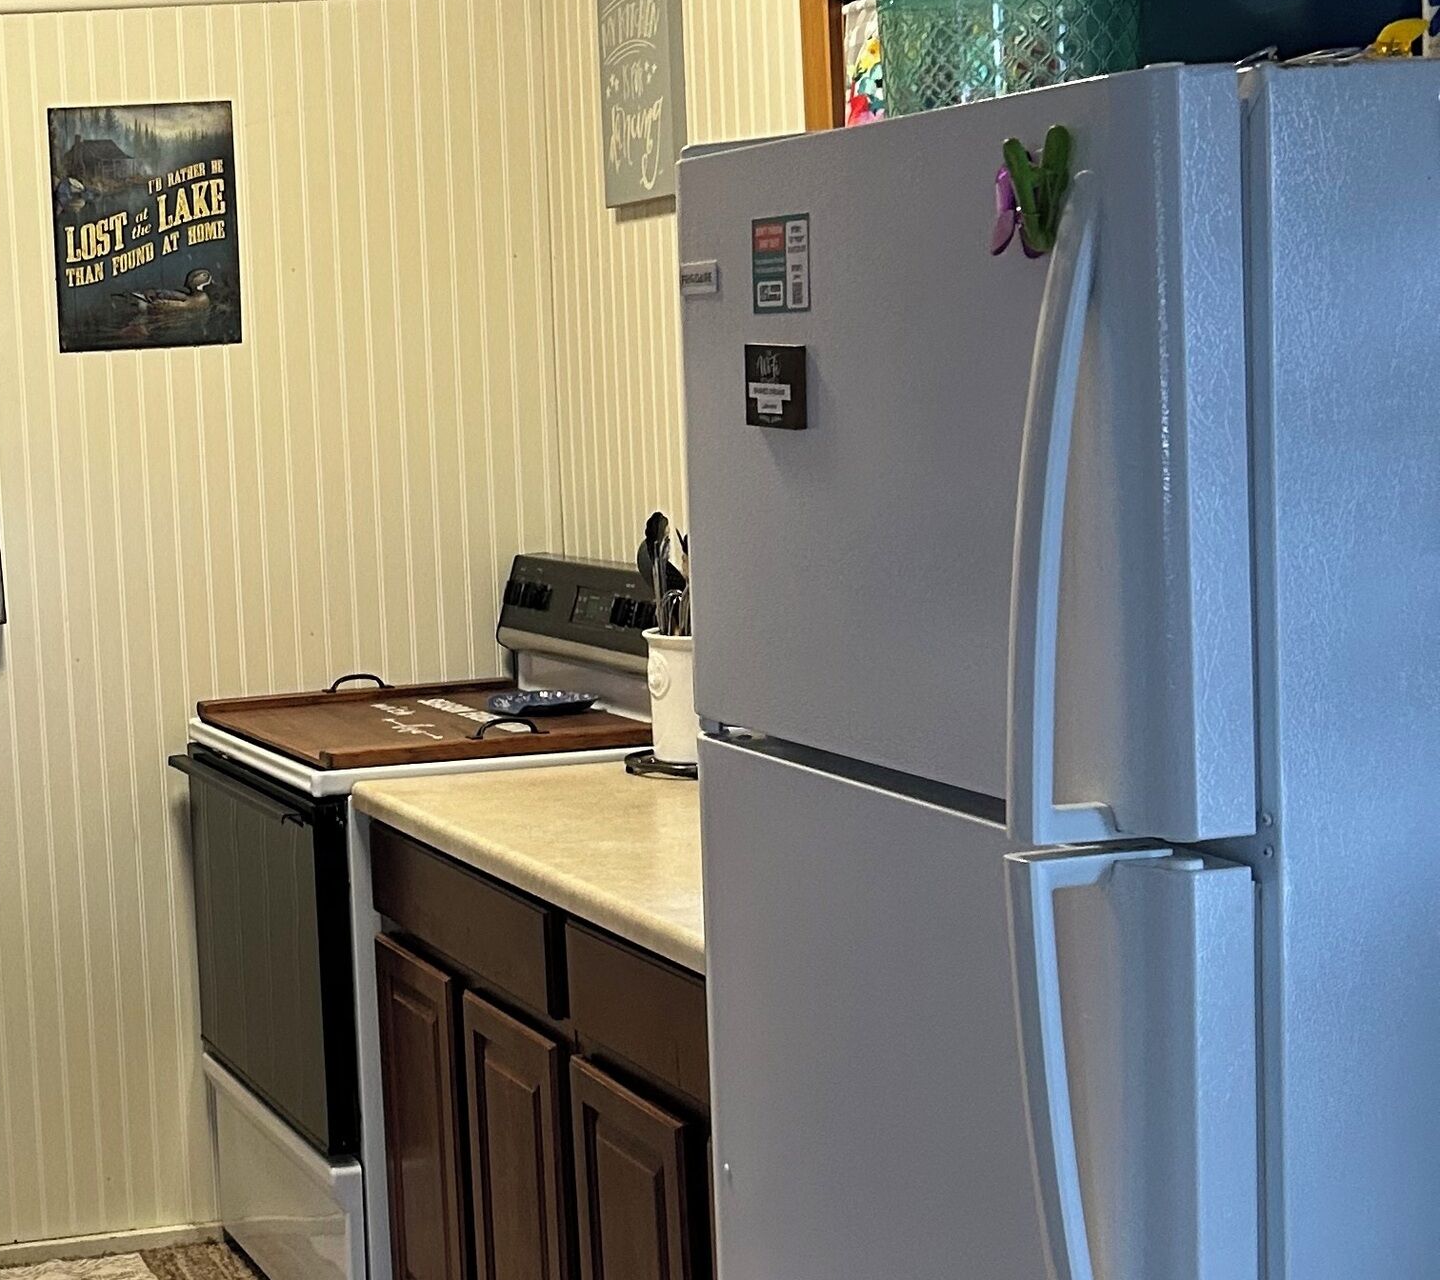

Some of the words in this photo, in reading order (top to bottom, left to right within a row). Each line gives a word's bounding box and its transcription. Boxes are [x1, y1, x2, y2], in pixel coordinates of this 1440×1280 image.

[148, 176, 163, 195] I'D
[167, 162, 205, 187] RATHER
[211, 159, 224, 174] BE
[135, 207, 149, 224] at
[157, 178, 227, 233] LAKE
[64, 211, 128, 263] LOST
[65, 261, 105, 287] THAN
[111, 241, 155, 277] FOUND
[162, 231, 180, 255] AT
[187, 220, 226, 246] HOME
[131, 223, 152, 240] the
